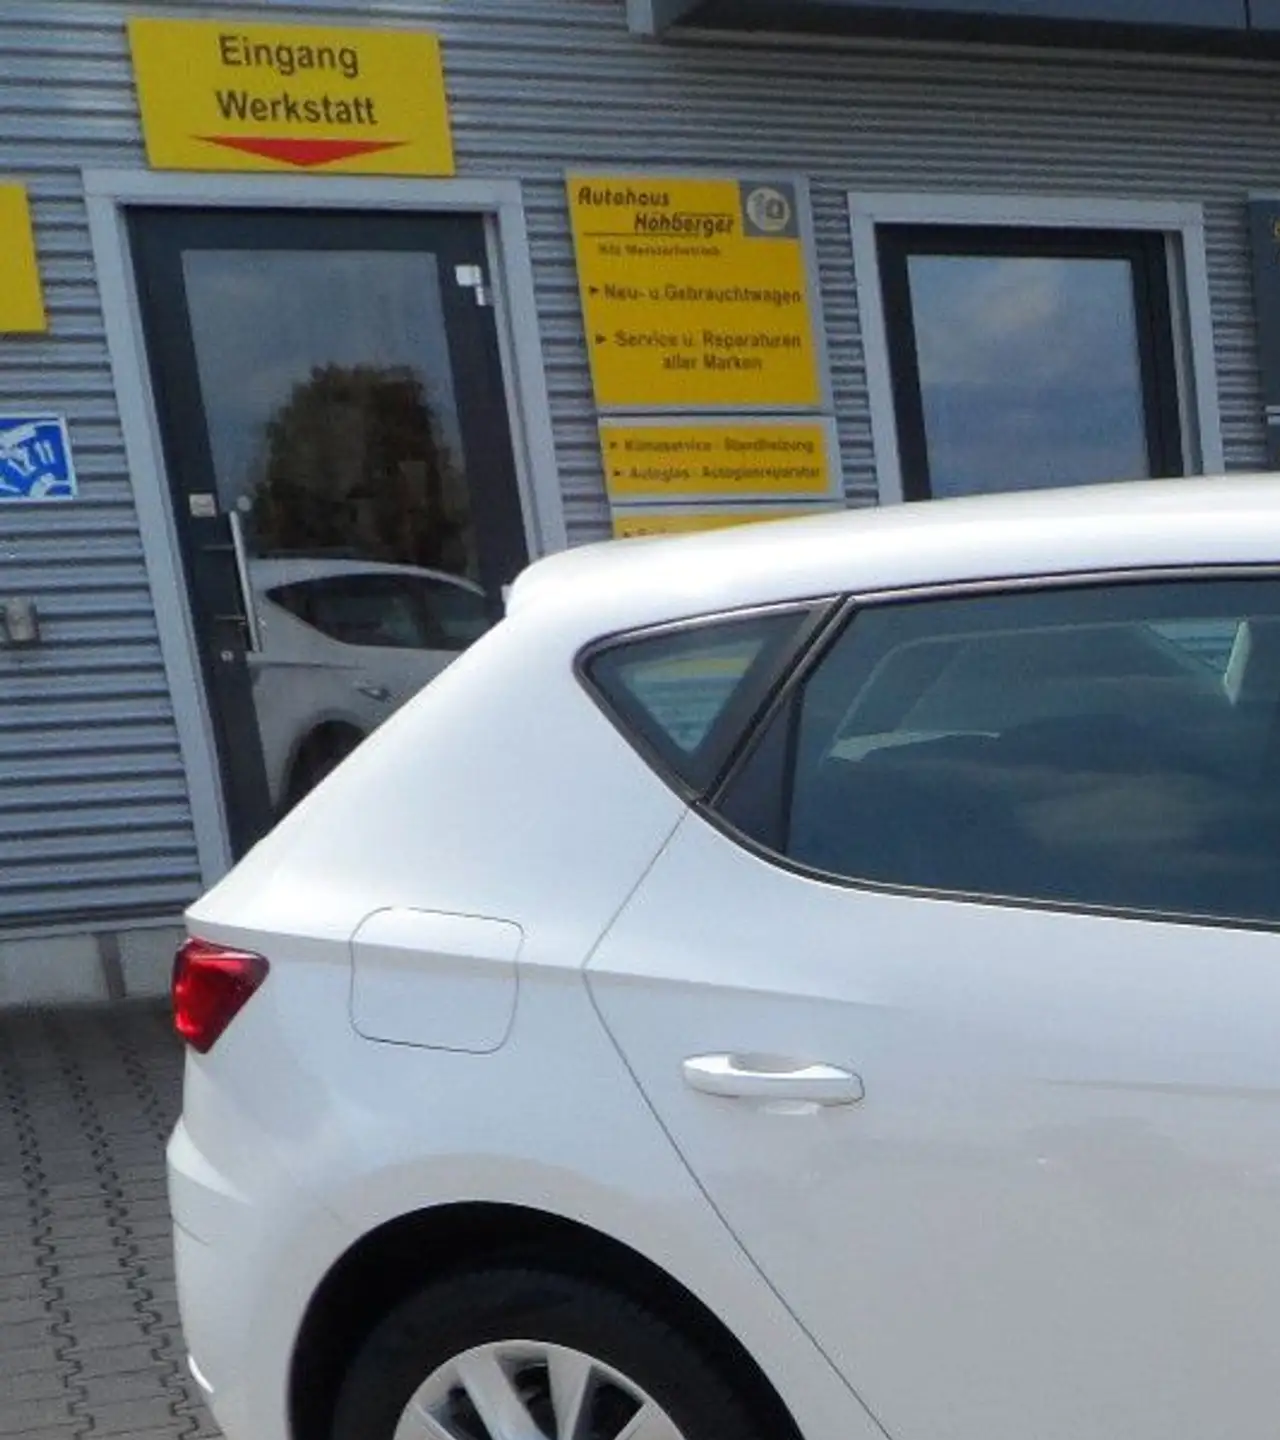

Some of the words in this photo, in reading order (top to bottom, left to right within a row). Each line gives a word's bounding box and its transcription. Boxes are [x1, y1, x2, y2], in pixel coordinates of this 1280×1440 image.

[218, 34, 359, 79] Eingang
[215, 89, 378, 126] Werkstatt
[578, 186, 670, 207] Autohaus
[664, 283, 801, 306] Gebrauchtwagen
[613, 329, 678, 348] Service
[702, 330, 801, 351] Reparaturen
[703, 354, 762, 370] Marken
